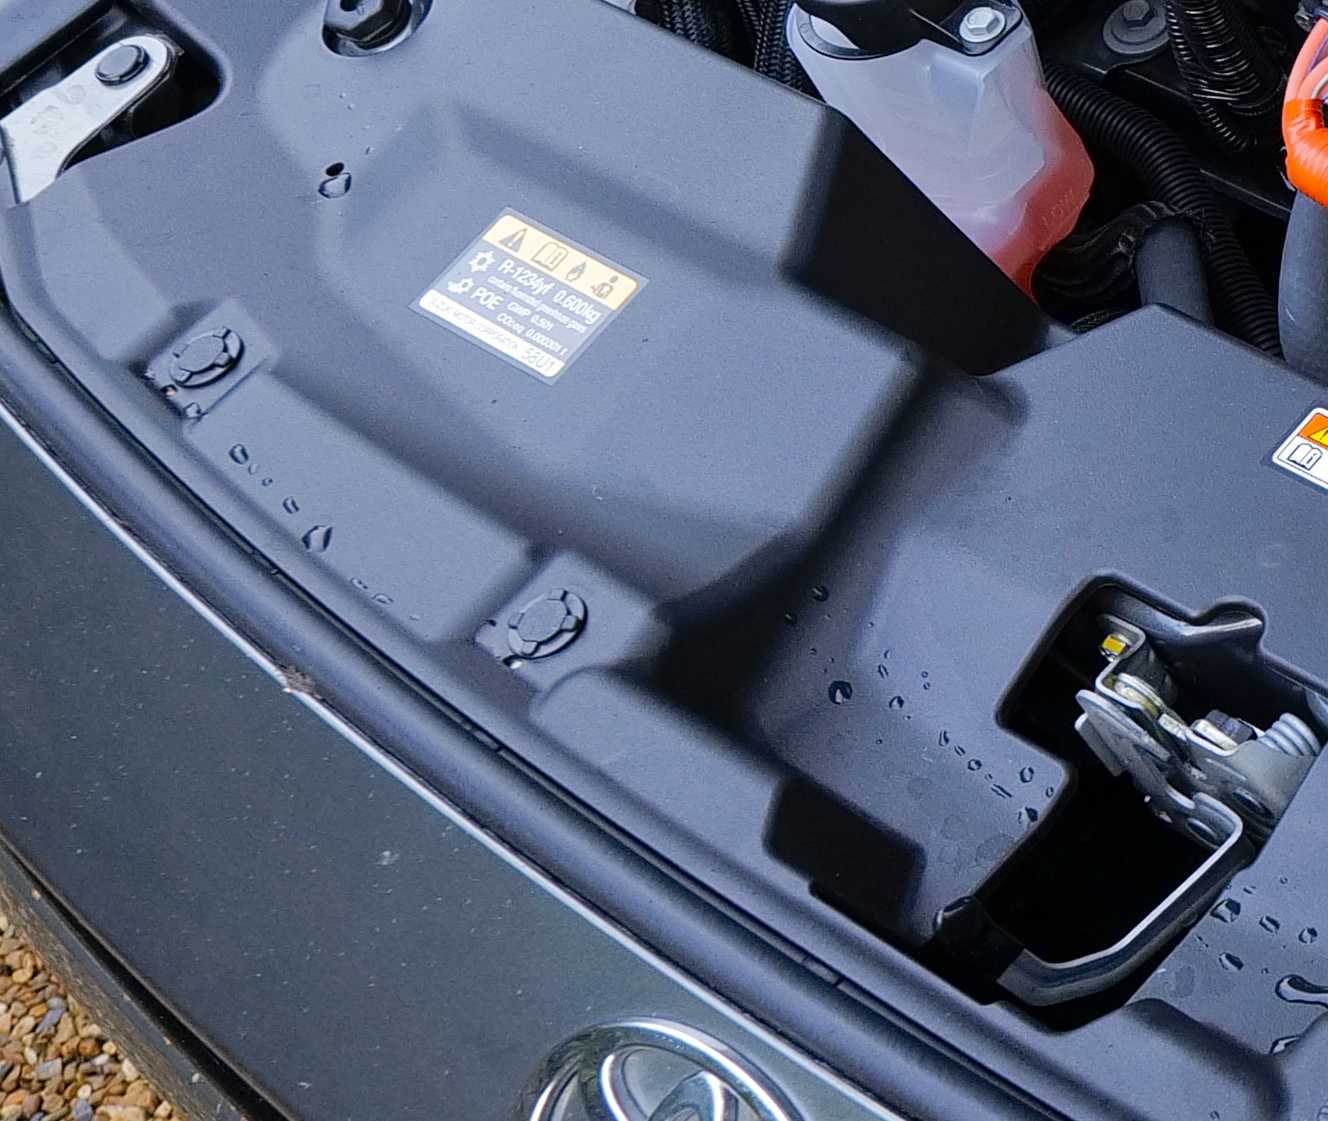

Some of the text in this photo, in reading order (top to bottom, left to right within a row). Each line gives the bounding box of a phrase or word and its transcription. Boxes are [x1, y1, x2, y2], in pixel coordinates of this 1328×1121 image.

[470, 286, 554, 331] POE GWP 0.501
[497, 258, 601, 324] R-1234yf 0.600kg
[452, 309, 476, 324] MOTOR
[521, 347, 555, 371] 58U1
